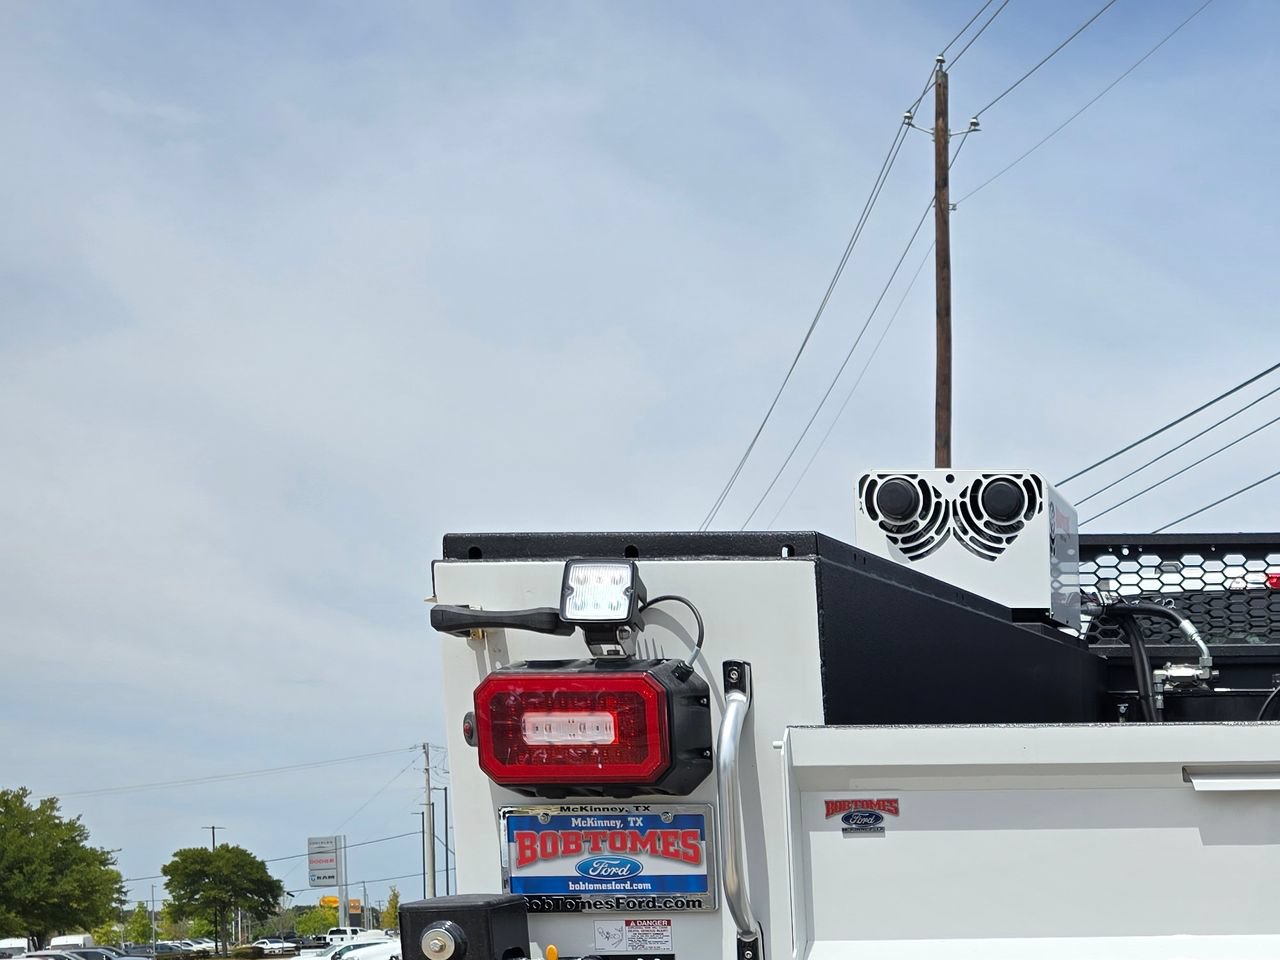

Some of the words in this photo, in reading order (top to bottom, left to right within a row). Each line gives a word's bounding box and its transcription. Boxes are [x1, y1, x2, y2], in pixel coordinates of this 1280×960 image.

[559, 805, 629, 813] McKinney,
[571, 817, 624, 828] McKinney,
[628, 817, 643, 827] TX
[849, 812, 876, 824] Ford
[588, 859, 631, 876] Ford
[569, 881, 652, 890] bobtomesford.com
